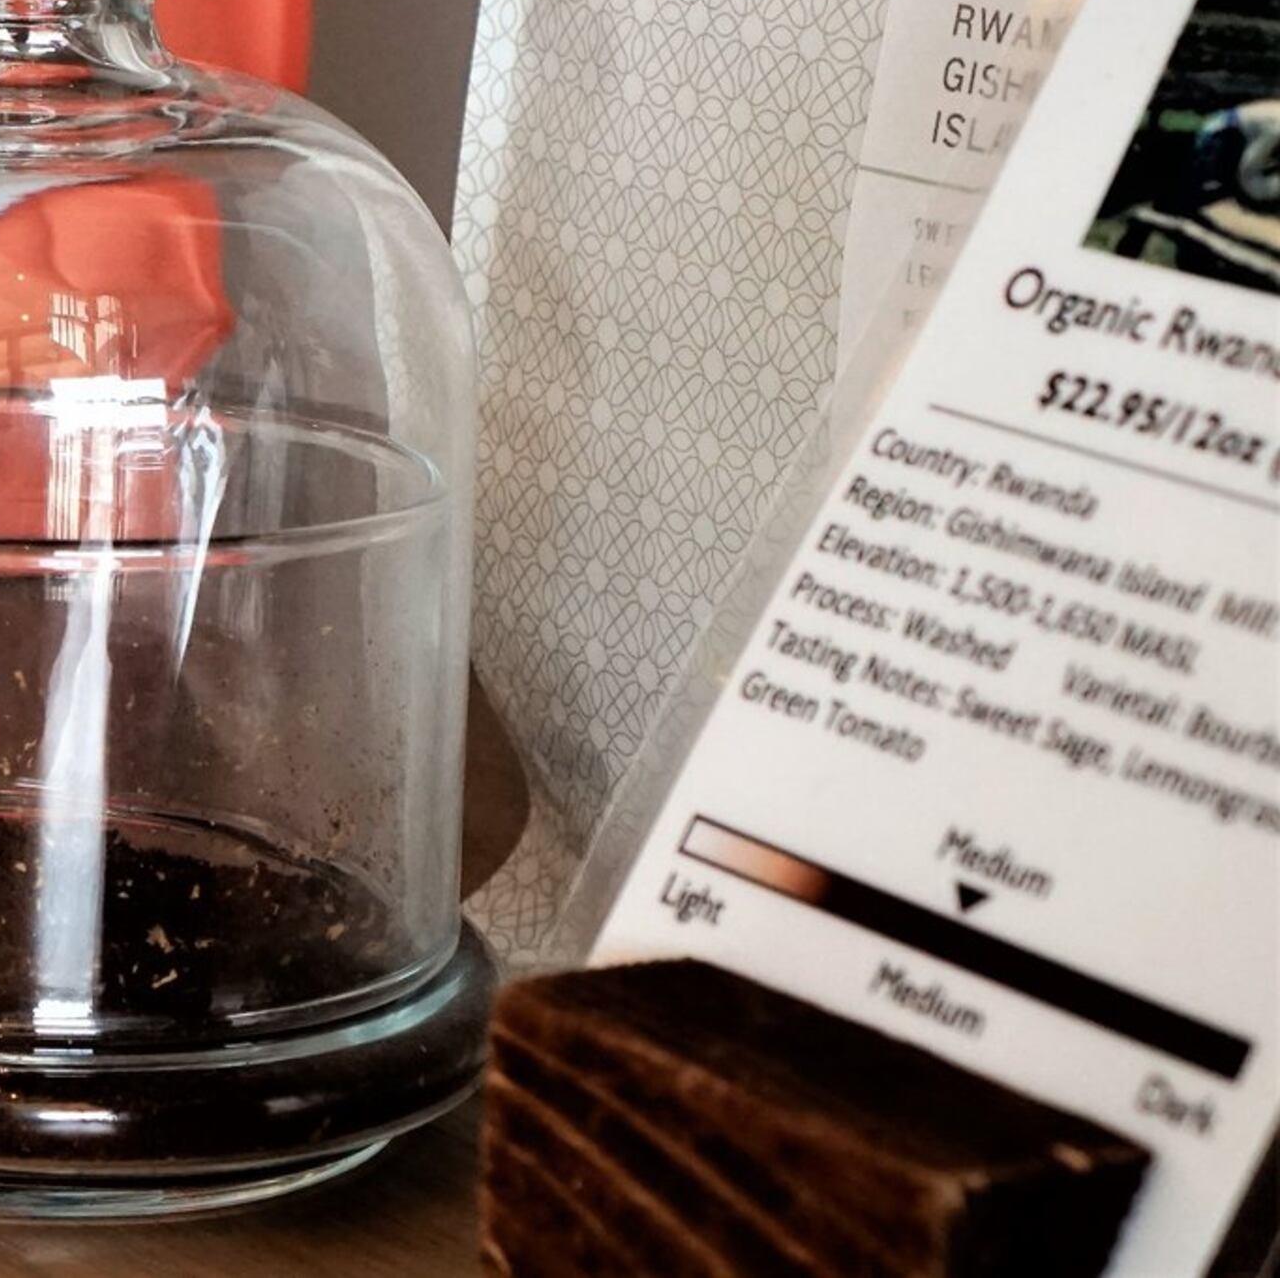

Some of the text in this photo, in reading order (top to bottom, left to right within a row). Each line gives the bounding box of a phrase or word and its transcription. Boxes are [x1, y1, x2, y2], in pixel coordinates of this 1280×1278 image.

[1004, 266, 1156, 335] Organic
[870, 427, 1100, 521] Country: Rwanda
[1038, 370, 1266, 466] $22.95/12oz
[816, 522, 1202, 677] Elevation: 1,500-1,650 MASL
[842, 473, 944, 529] Region:
[944, 506, 1113, 586] Gishimwana
[1114, 559, 1211, 614] Island
[766, 618, 859, 685] Tasting
[860, 653, 952, 711] Notes:
[949, 684, 1042, 744] Sweet
[1040, 716, 1117, 777] Sage,
[790, 570, 900, 633] Process:
[902, 608, 1020, 672] Washed
[1061, 660, 1181, 730] Varietal:
[739, 671, 928, 765] Green Tomato
[937, 825, 1054, 900] Medium
[658, 872, 1219, 1136] Light Medium Dark
